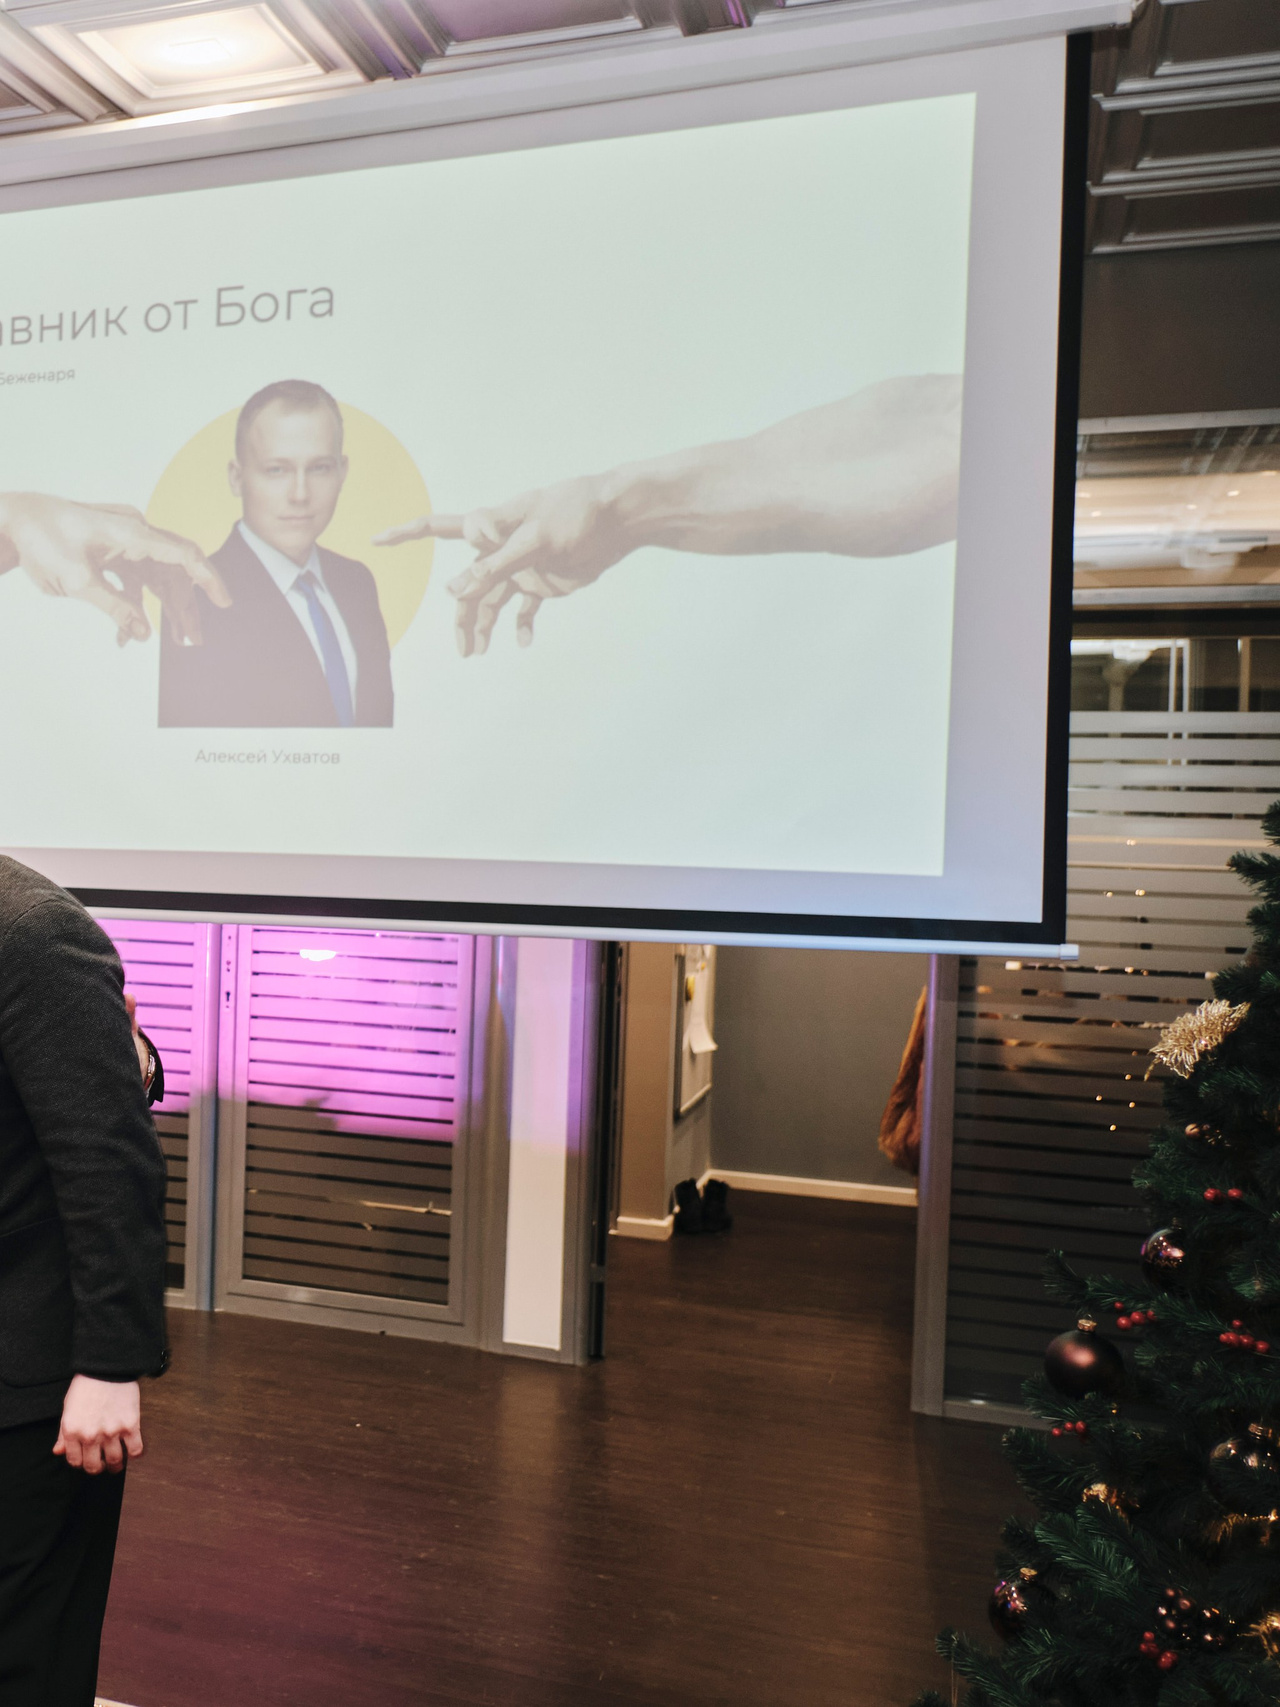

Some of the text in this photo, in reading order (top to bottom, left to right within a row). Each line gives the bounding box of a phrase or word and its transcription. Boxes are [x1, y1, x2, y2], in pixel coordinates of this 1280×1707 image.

[143, 299, 199, 334] от
[214, 284, 336, 328] Бога
[195, 749, 341, 765] Алексей Ухватов
